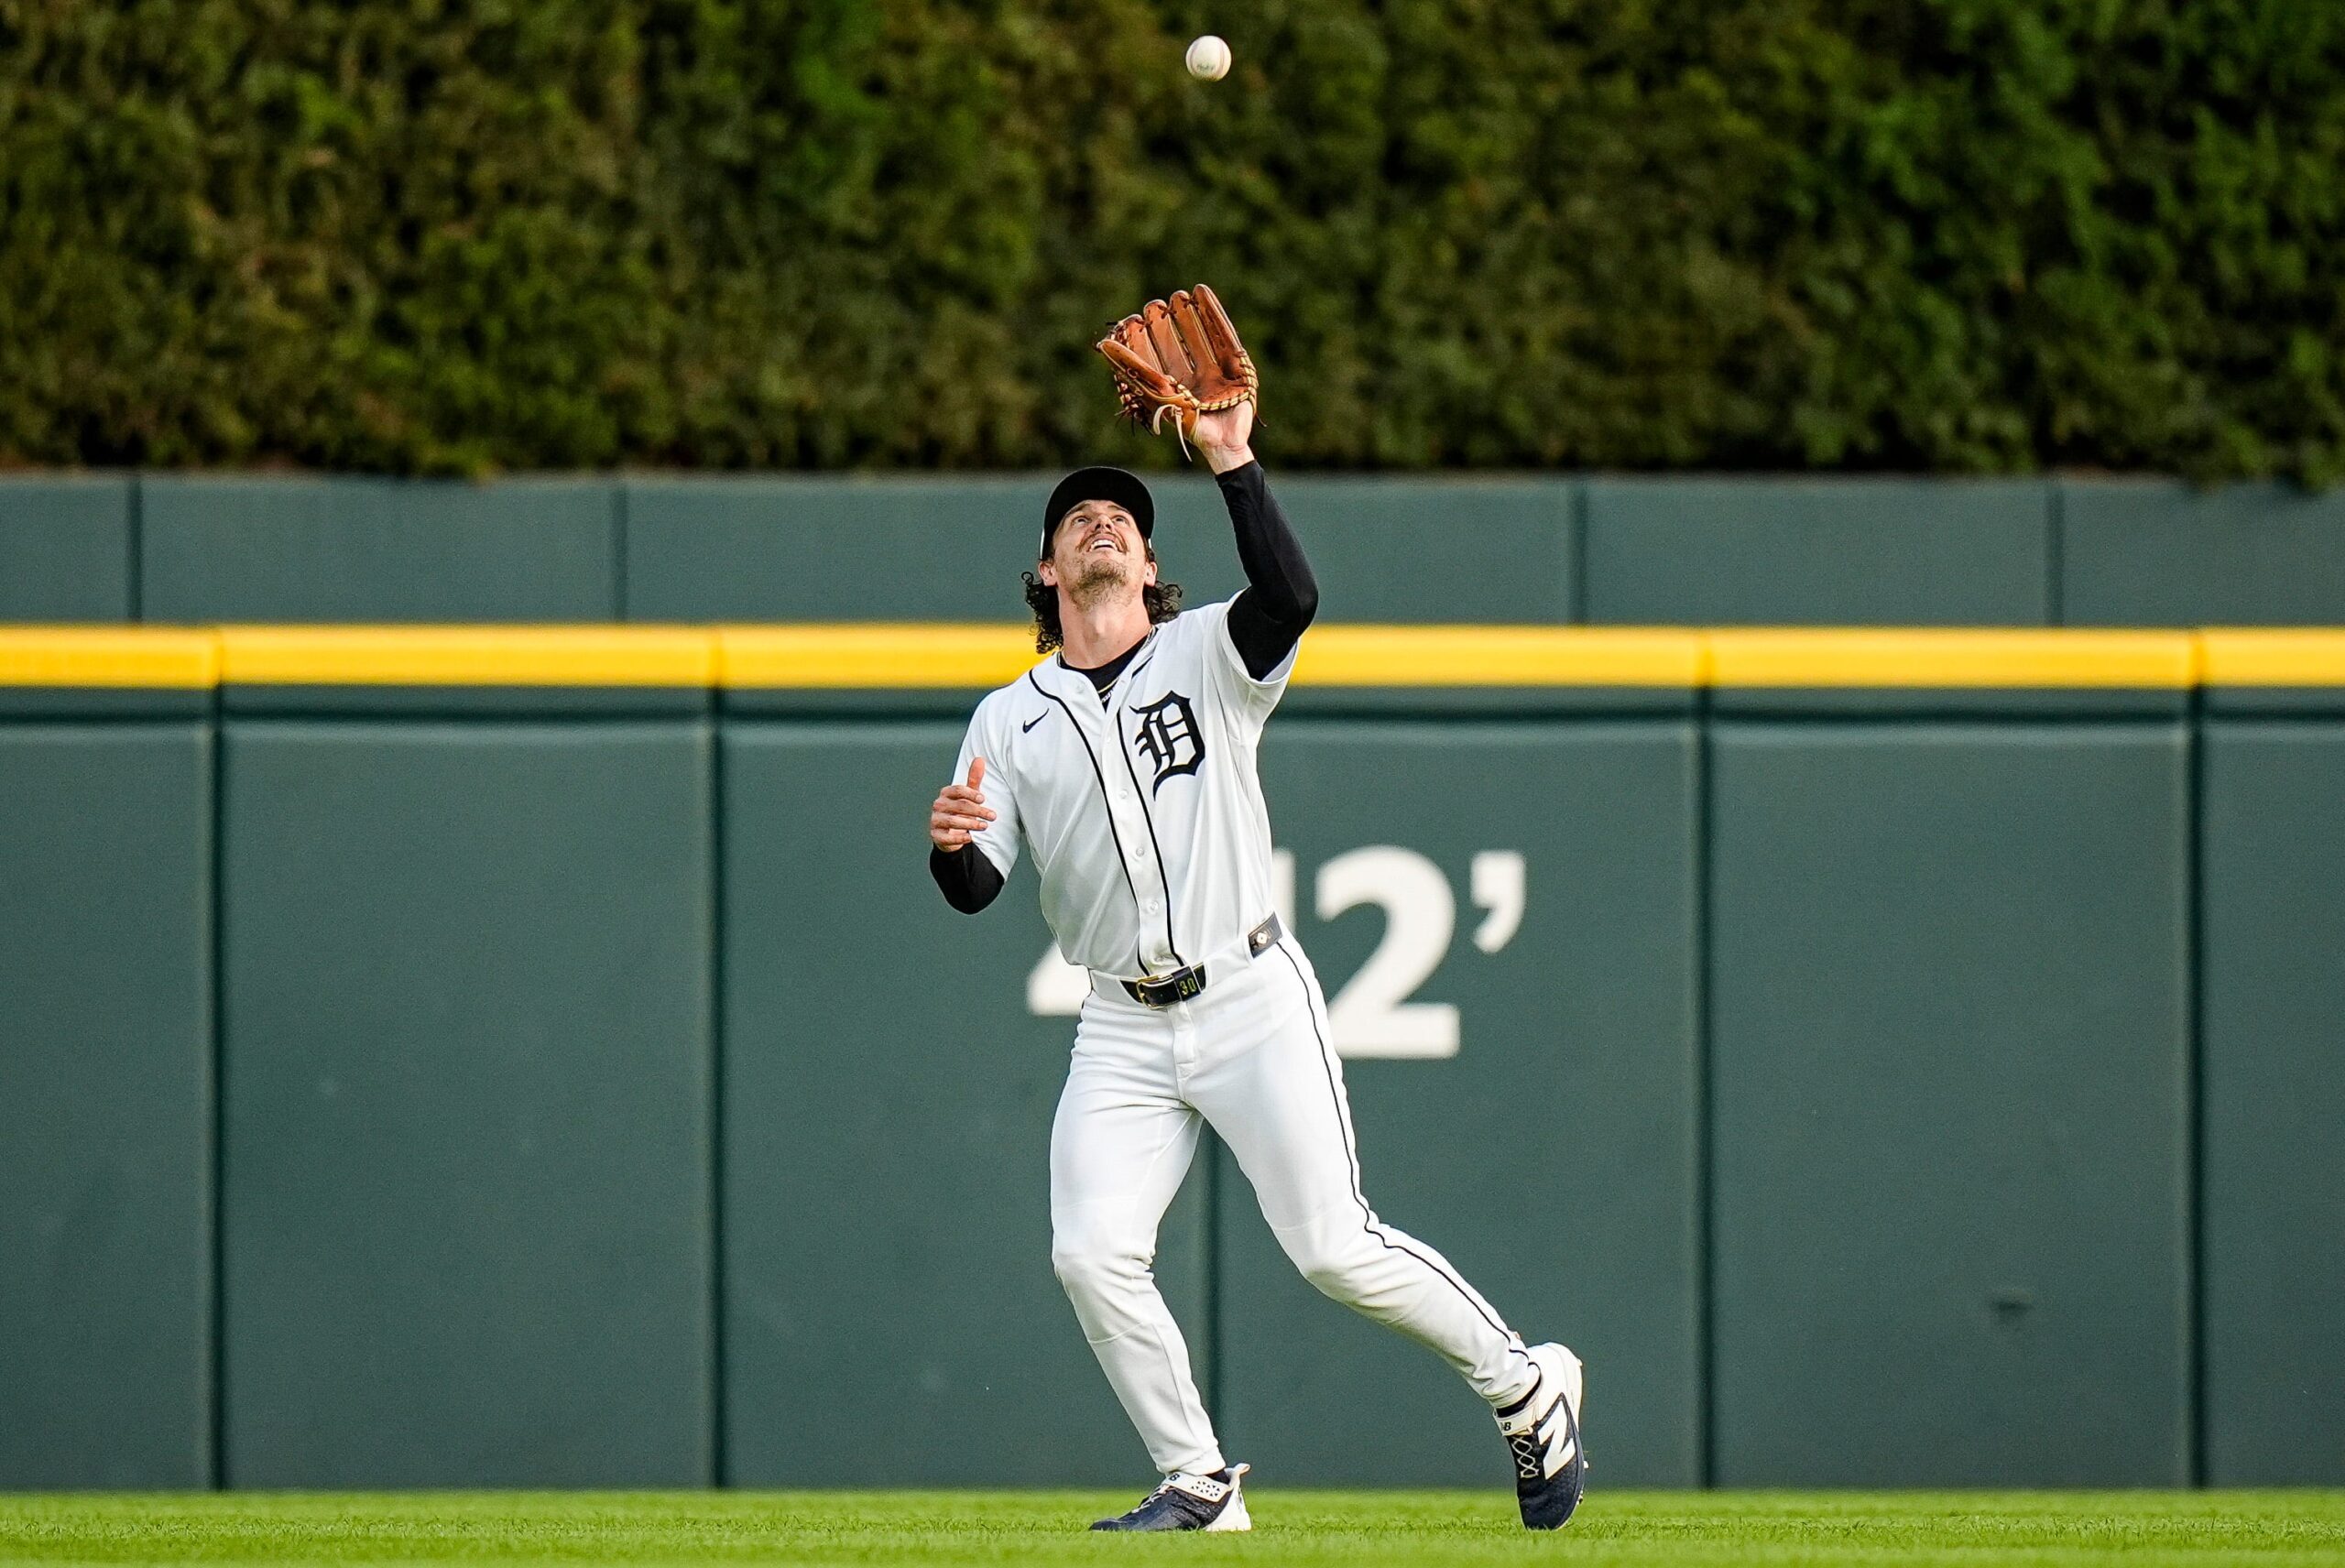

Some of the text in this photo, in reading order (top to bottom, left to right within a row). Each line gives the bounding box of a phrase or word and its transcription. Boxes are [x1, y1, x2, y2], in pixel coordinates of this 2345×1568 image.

[1129, 691, 1206, 801] D
[1027, 844, 1527, 1060] 2'
[1179, 977, 1197, 996] 30
